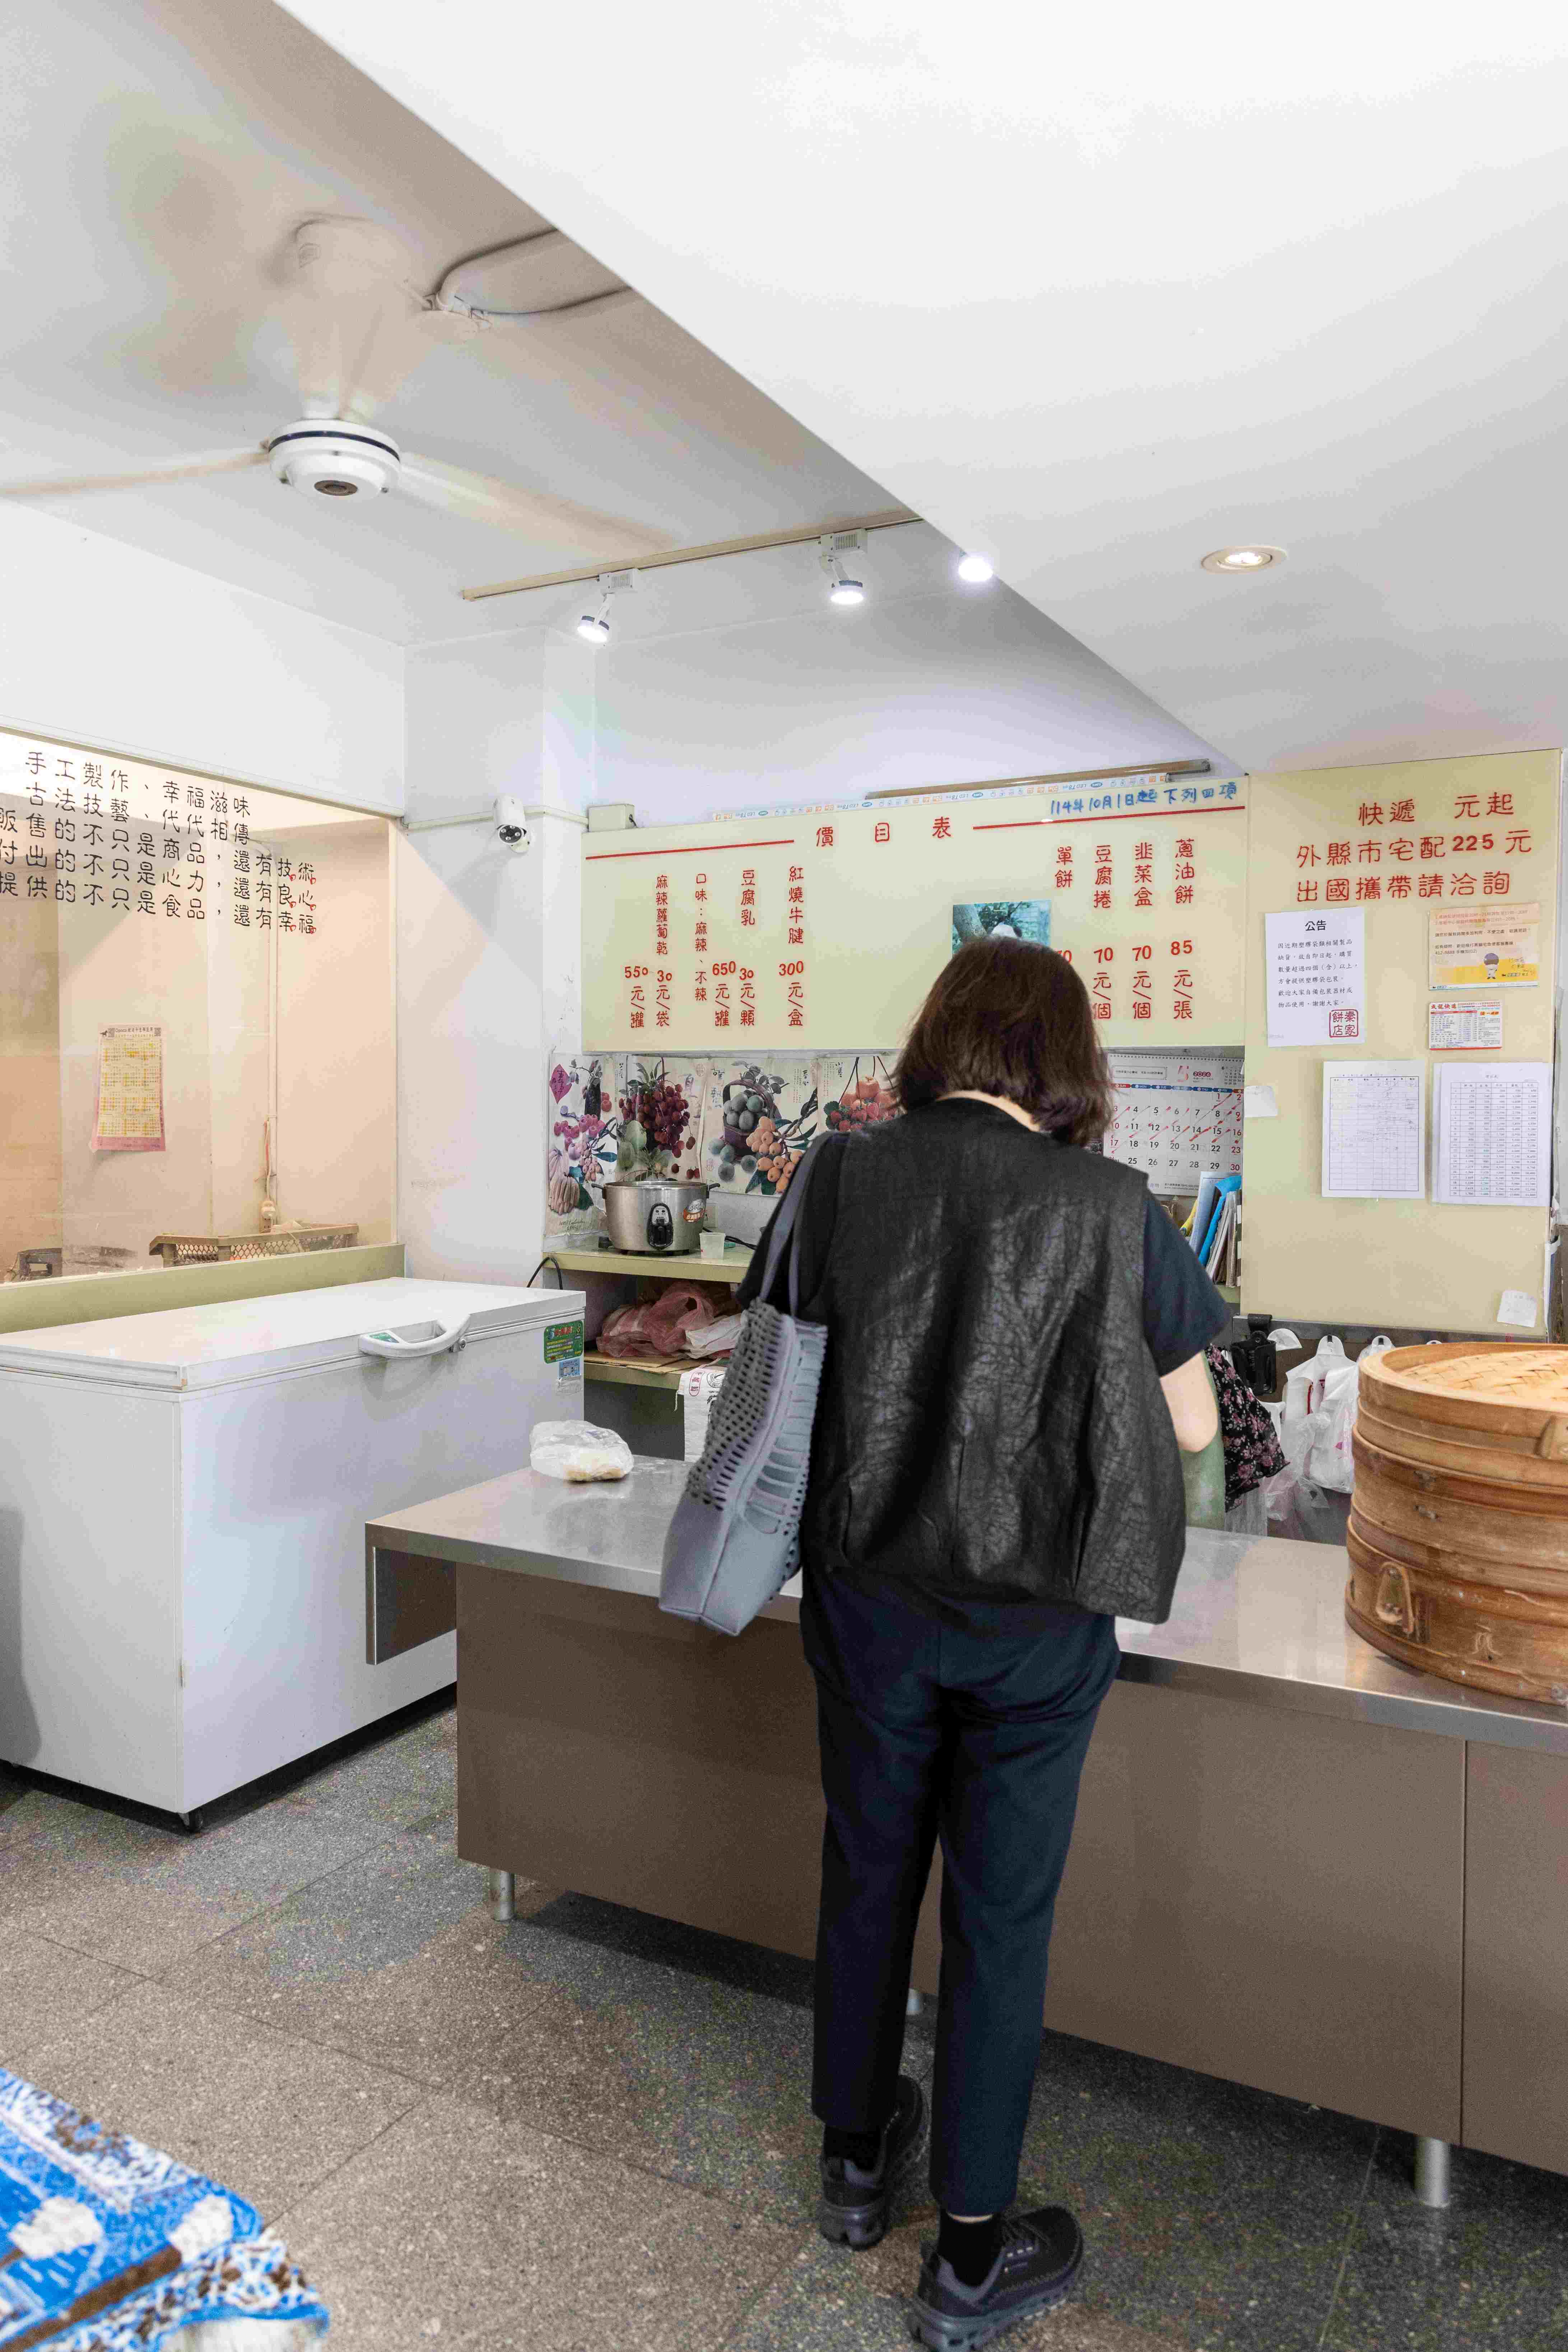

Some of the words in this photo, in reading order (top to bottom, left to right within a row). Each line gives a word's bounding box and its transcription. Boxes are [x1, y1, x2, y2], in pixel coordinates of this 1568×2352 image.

[25, 751, 250, 818] 手工製作、幸福滋味
[26, 781, 250, 845] 古法技藝、代代相傳
[1358, 798, 1416, 826] 快遞
[1454, 792, 1515, 820] 元起
[816, 816, 951, 847] 價目表
[1054, 846, 1074, 888] 單餅
[1093, 844, 1113, 909] 豆腐捲
[1134, 842, 1153, 907] 韭菜盒
[1174, 838, 1196, 904] 蔥油餅
[1297, 870, 1510, 903] 出國攜帶請洽詢
[656, 874, 668, 955] 麻辣蘿蔔乾
[740, 870, 755, 926] 豆腐乳
[788, 866, 804, 944] 紅燒牛腱
[1305, 919, 1327, 931] 公告
[1278, 939, 1353, 949] 因近期塑膠袋類相關製品
